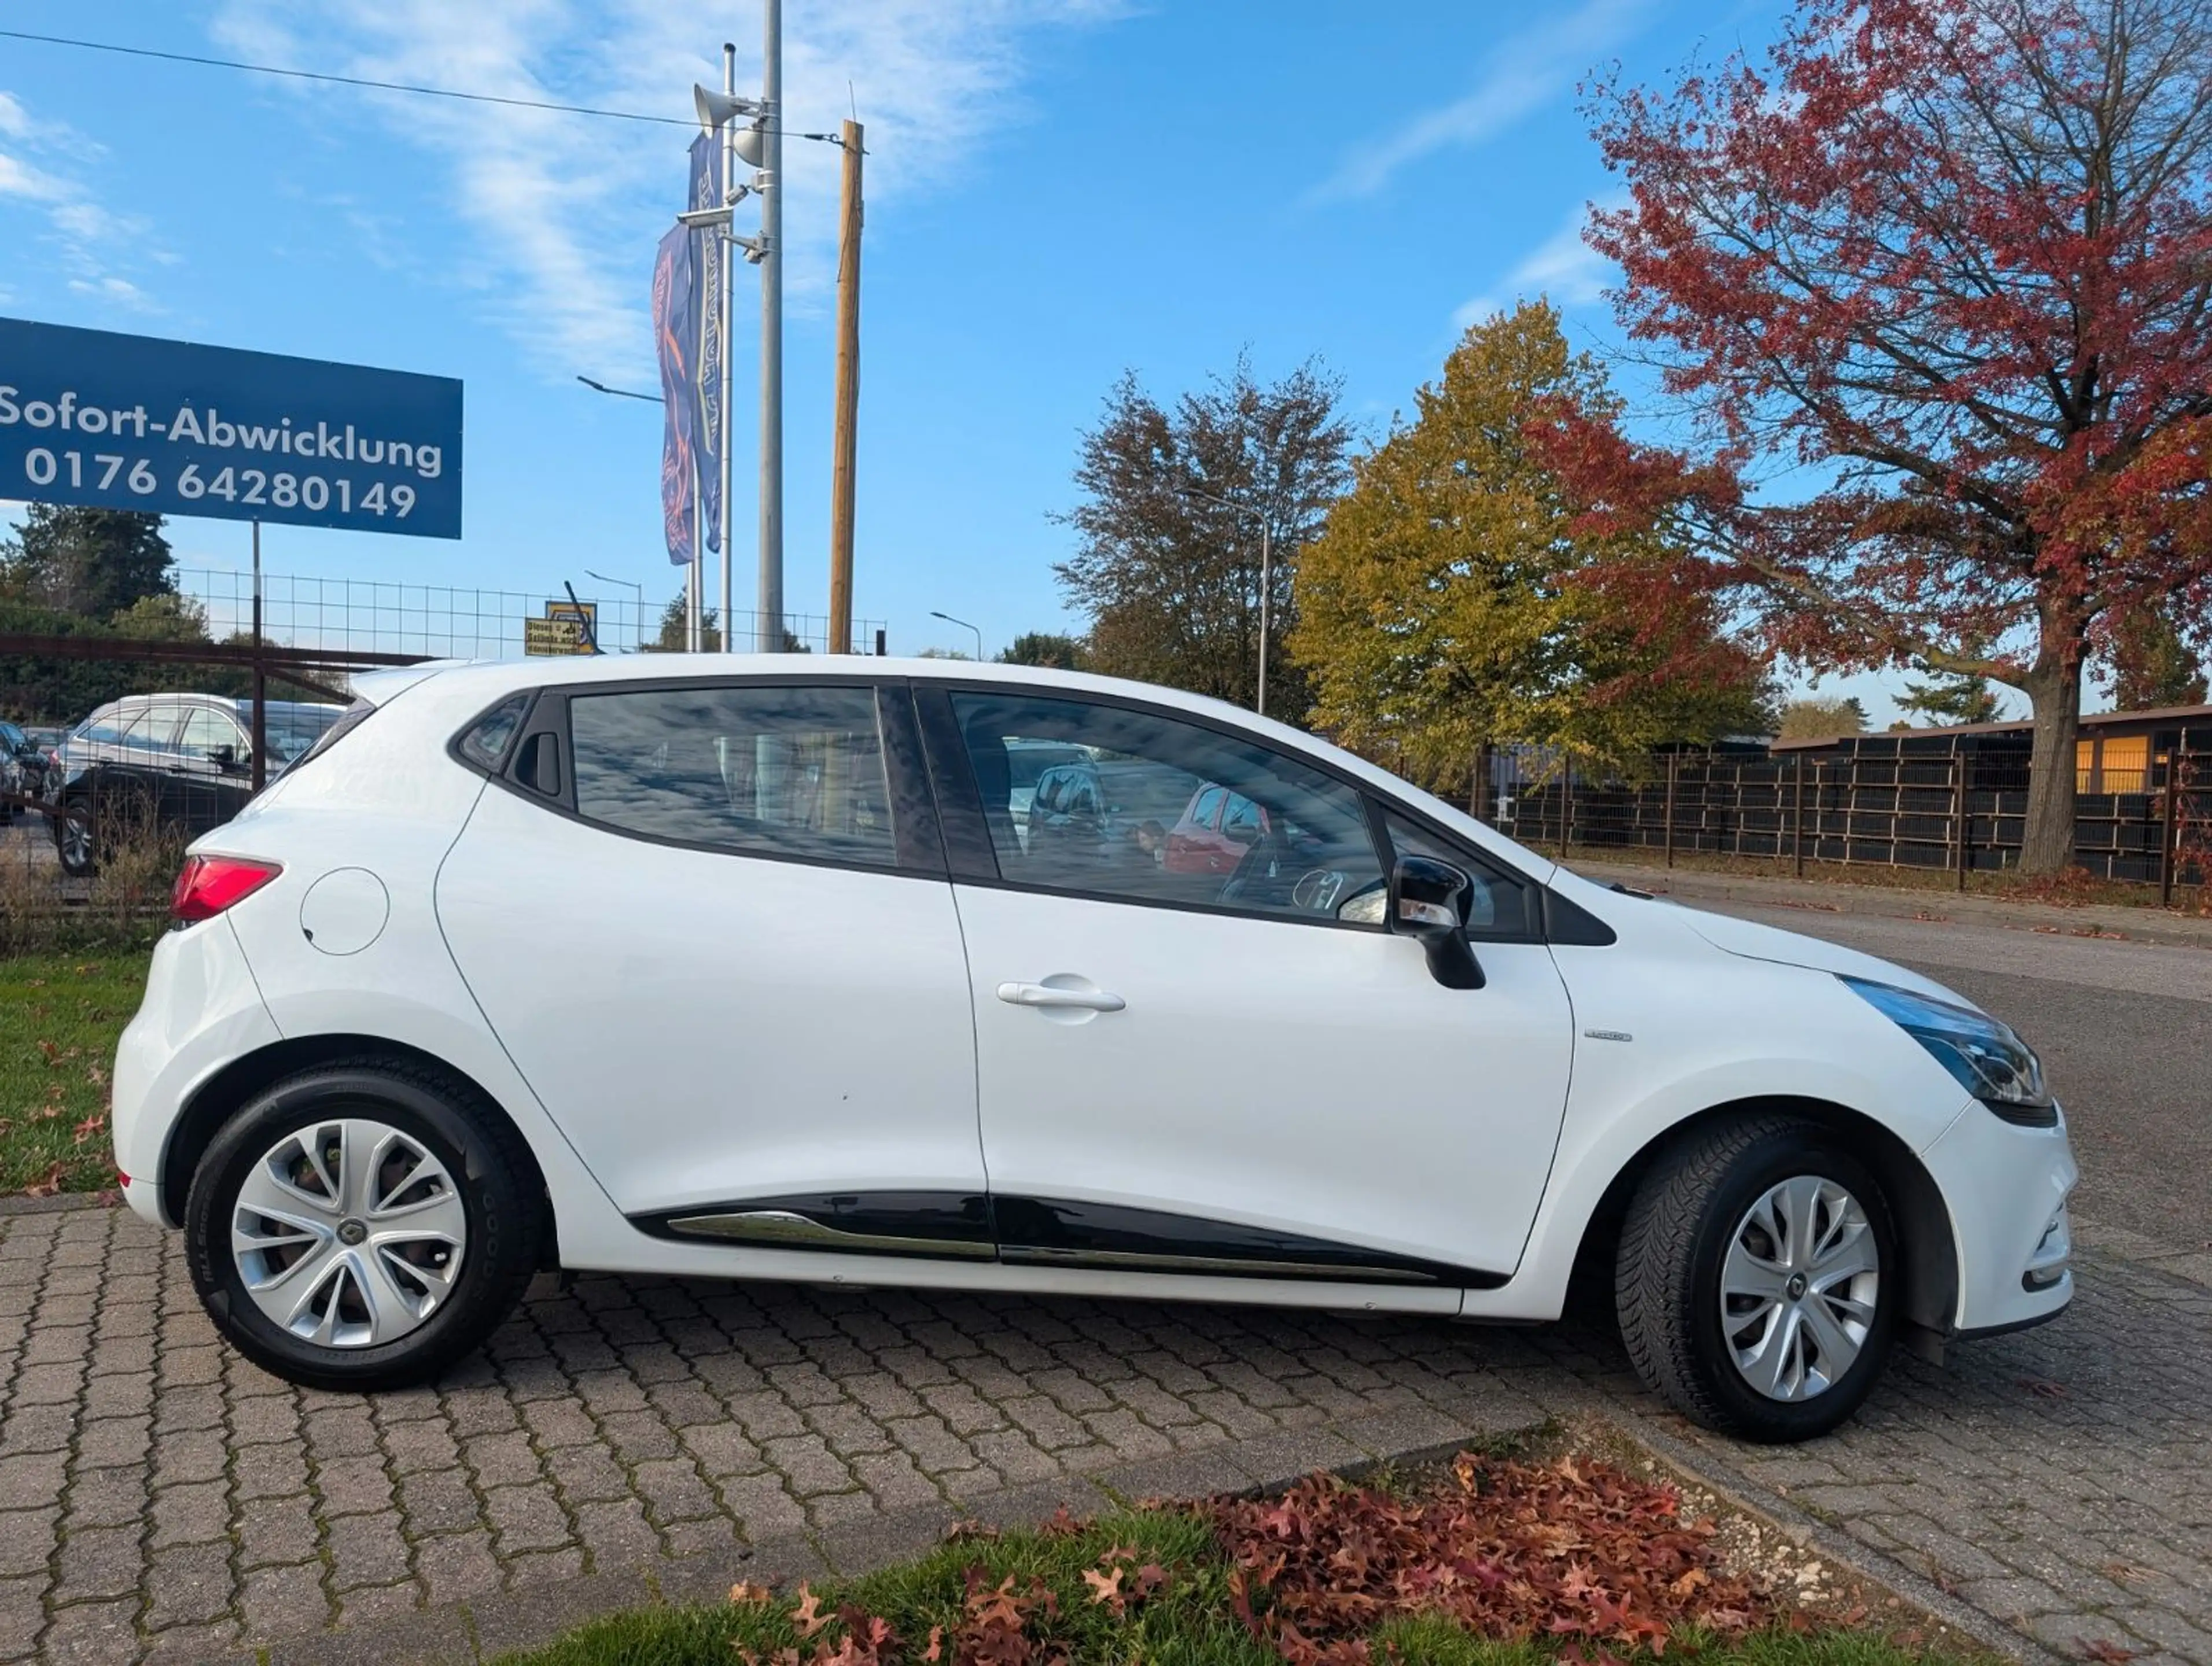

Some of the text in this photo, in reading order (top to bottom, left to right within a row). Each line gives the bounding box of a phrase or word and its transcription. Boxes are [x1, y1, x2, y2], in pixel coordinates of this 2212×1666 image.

[0, 386, 441, 478] Sofort-Abwicklung
[25, 448, 415, 518] 0176 64280149
